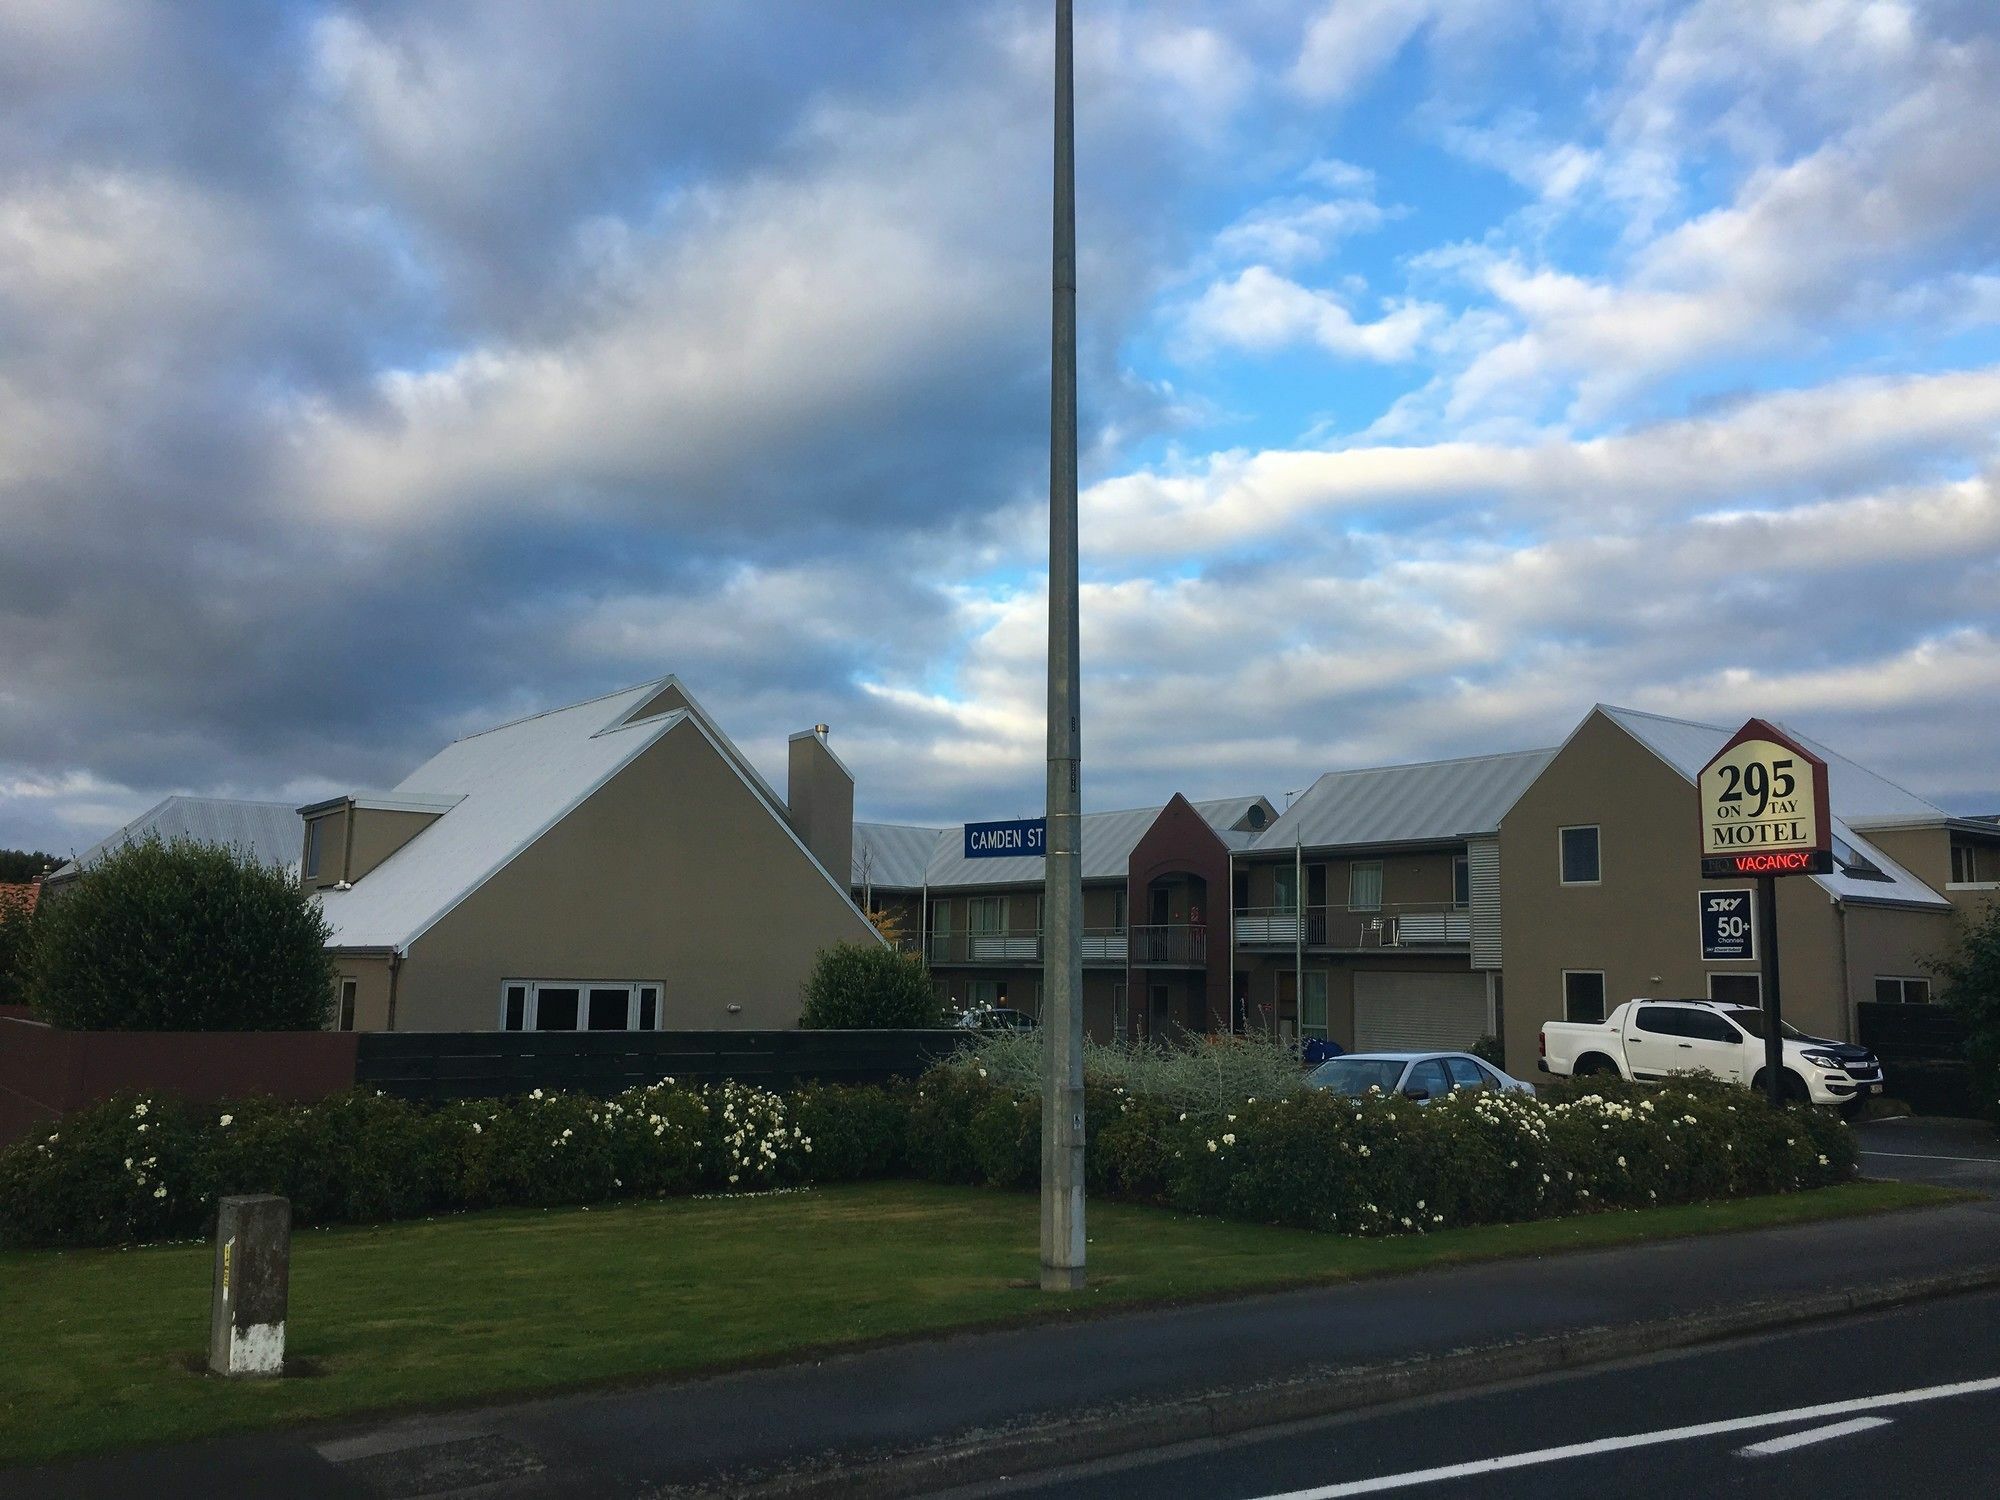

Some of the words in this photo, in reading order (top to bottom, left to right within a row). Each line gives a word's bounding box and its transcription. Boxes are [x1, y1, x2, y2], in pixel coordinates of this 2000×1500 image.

[1718, 760, 1795, 818] 295
[1717, 805, 1741, 819] ON
[1768, 800, 1798, 814] TAY
[971, 829, 1022, 850] CAMDEN
[1027, 828, 1043, 847] ST
[1712, 822, 1807, 846] MOTEL
[1735, 854, 1809, 871] VACANCY
[1707, 898, 1743, 912] SKY
